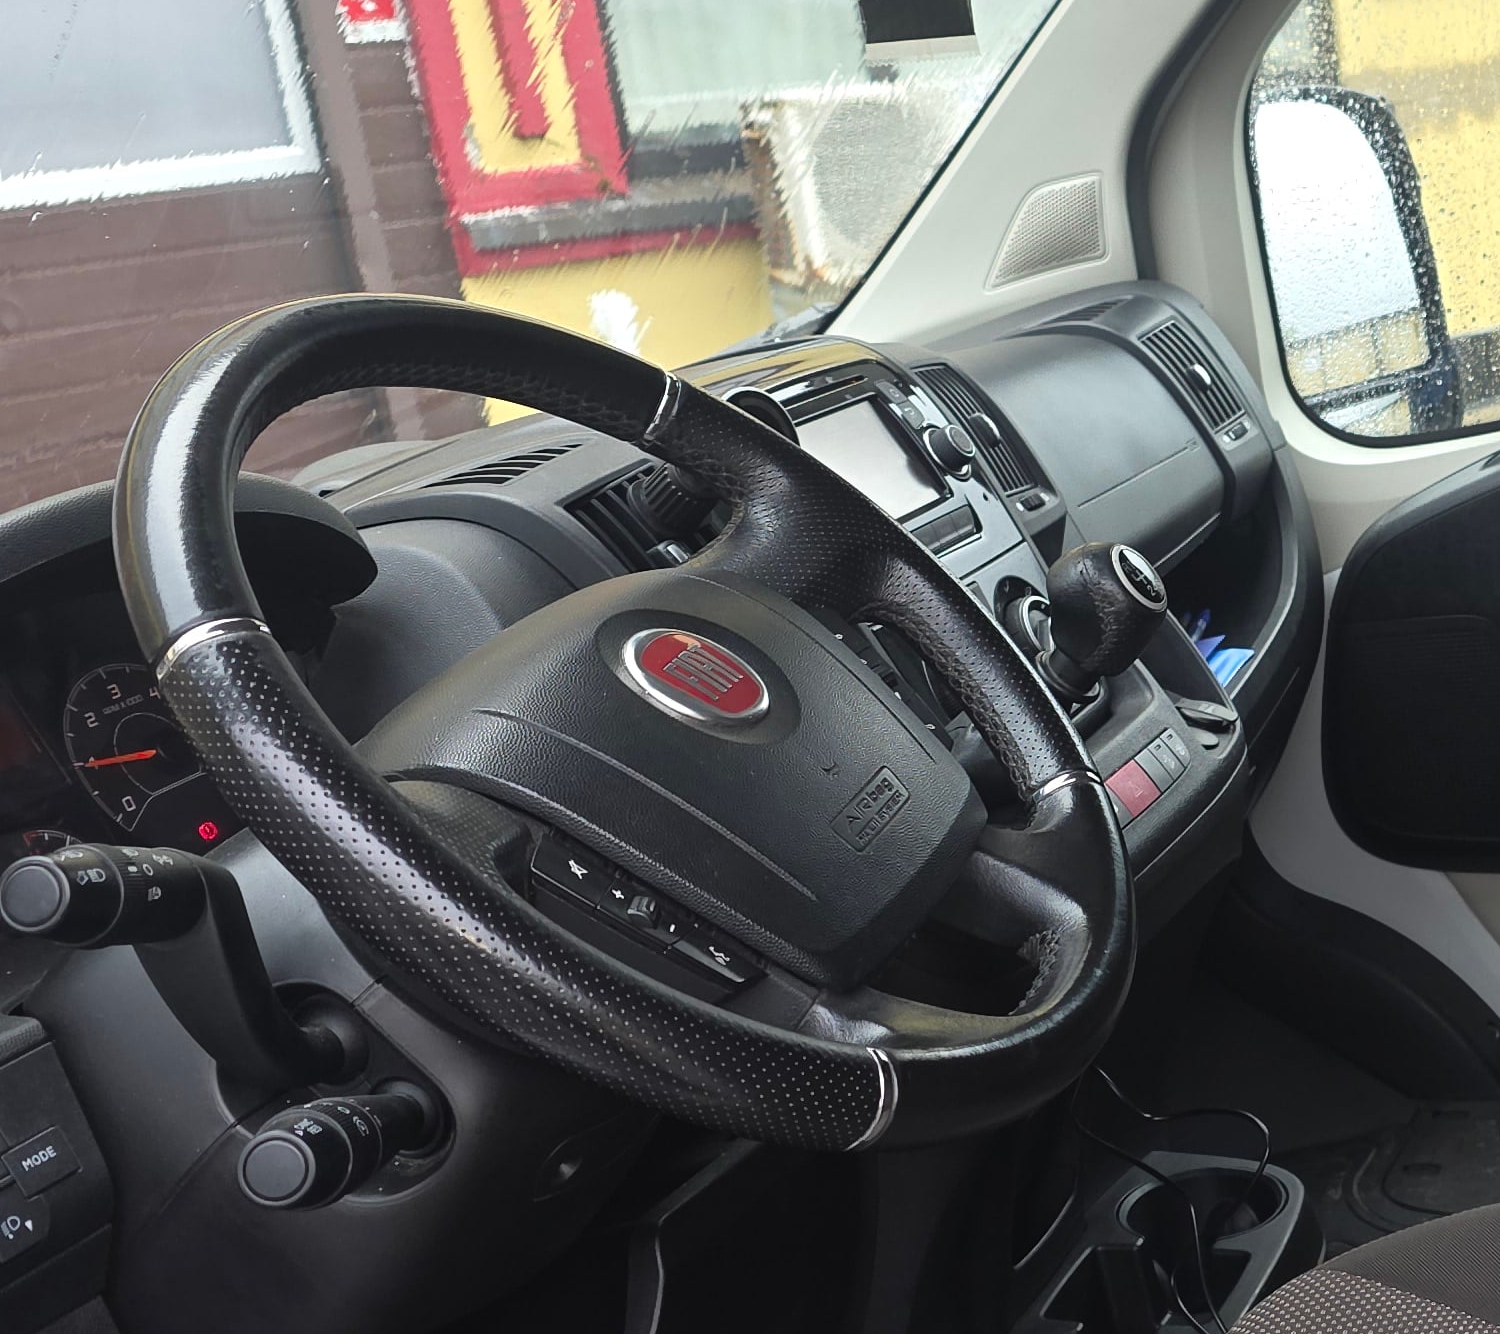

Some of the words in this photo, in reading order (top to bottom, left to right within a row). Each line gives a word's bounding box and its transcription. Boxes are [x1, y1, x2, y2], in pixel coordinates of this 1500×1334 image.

[662, 643, 744, 701] FIAT
[106, 683, 122, 700] 3
[148, 686, 161, 700] 4
[83, 711, 100, 729] 2
[121, 795, 137, 812] 0
[21, 1145, 57, 1172] MODE
